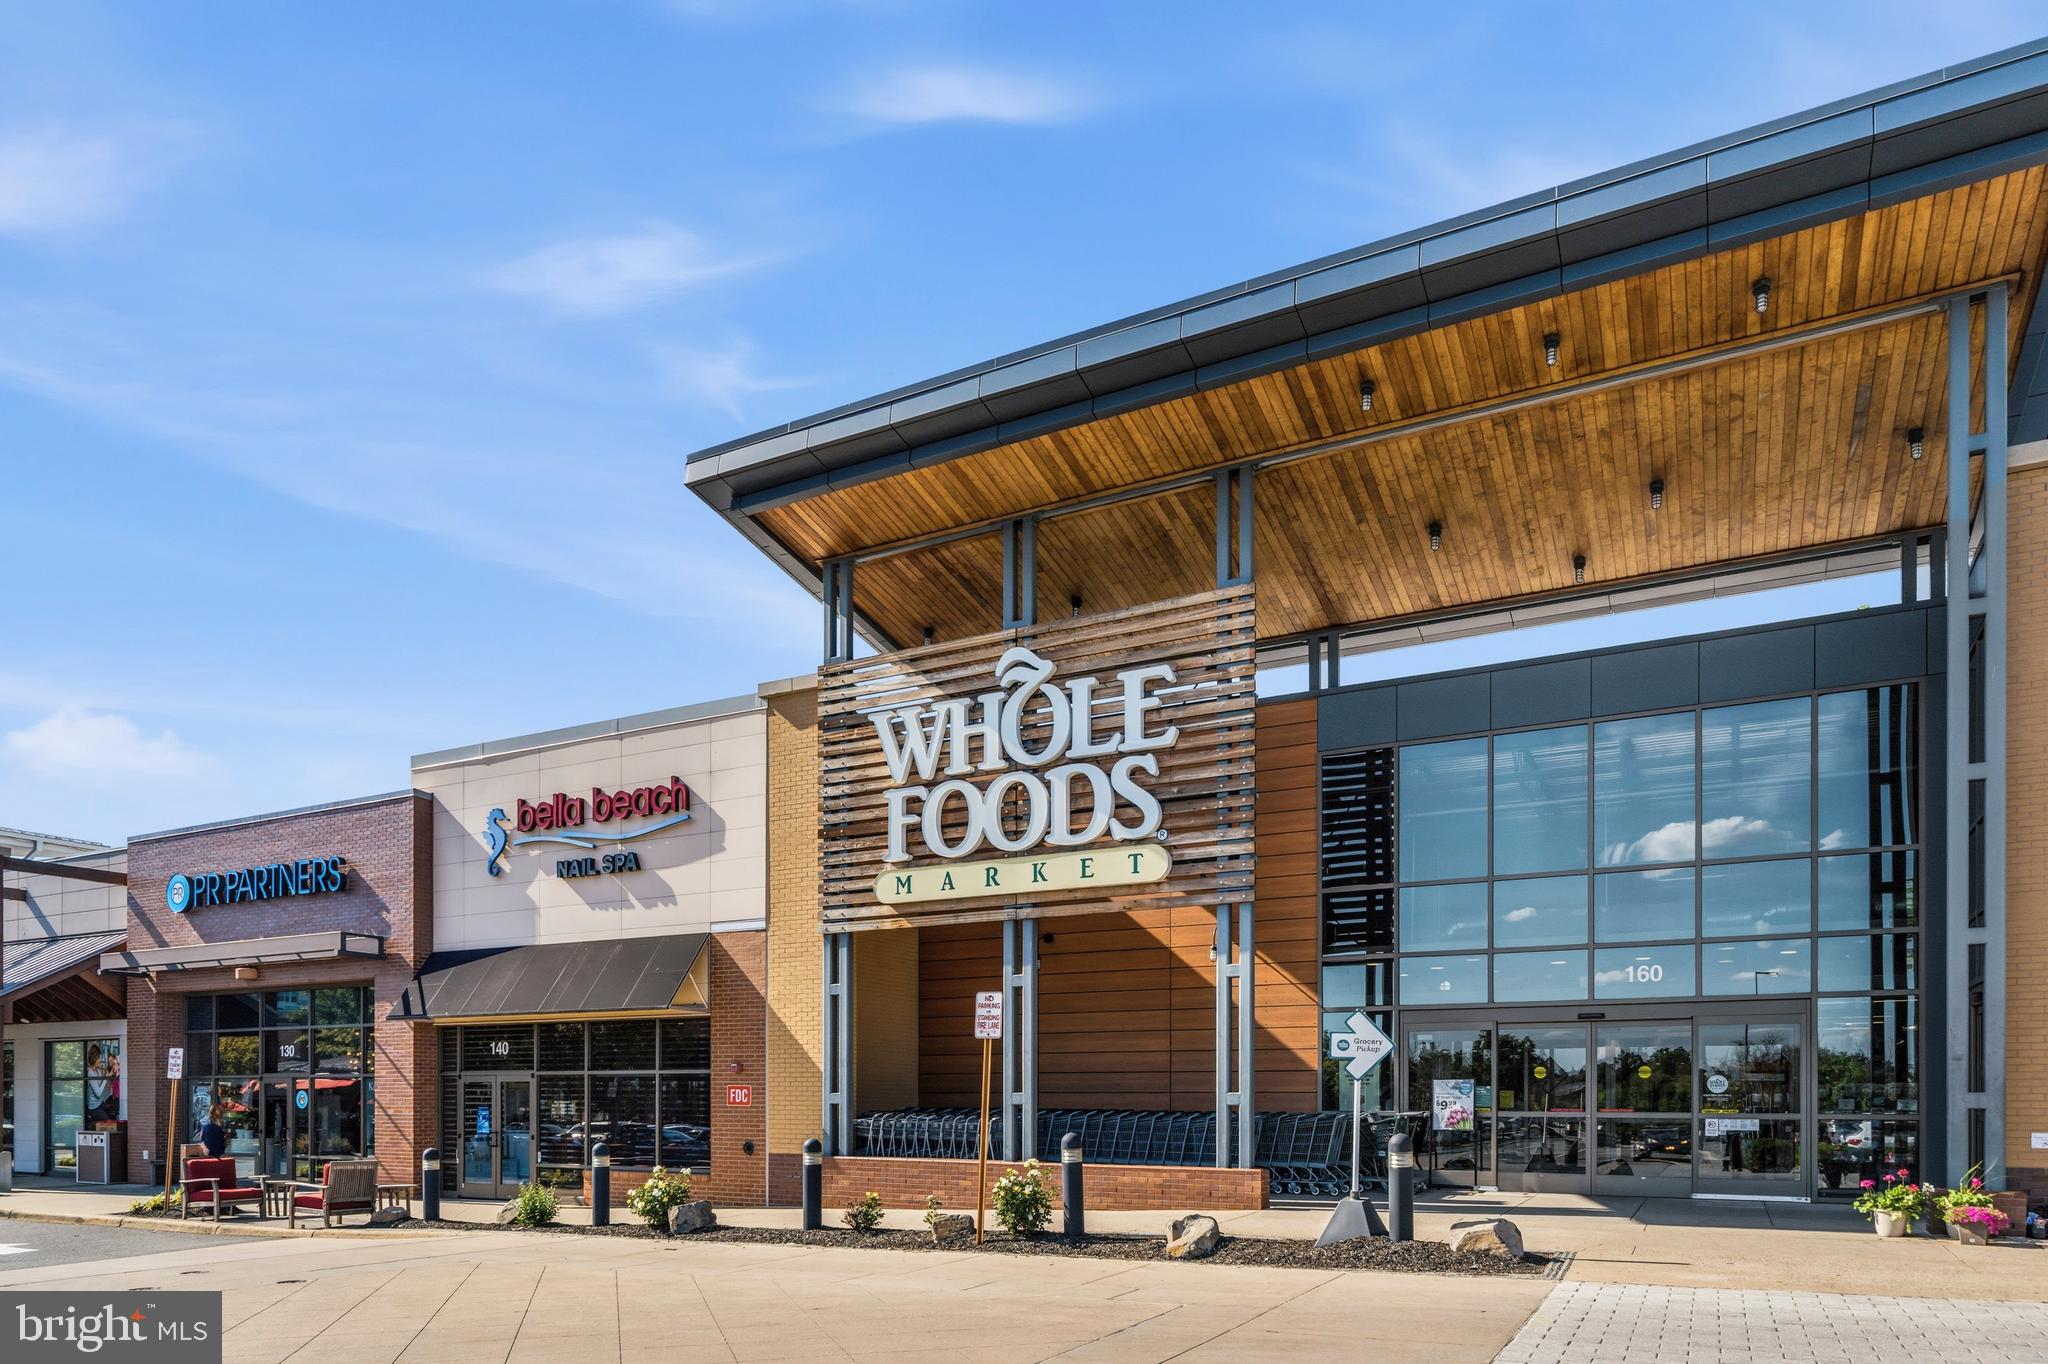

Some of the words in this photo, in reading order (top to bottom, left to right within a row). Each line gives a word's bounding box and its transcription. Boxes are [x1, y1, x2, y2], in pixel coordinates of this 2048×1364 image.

[867, 647, 1180, 785] WHOLE
[517, 798, 585, 832] bella
[592, 776, 691, 823] beach
[881, 753, 1163, 863] FOODS
[556, 857, 599, 879] NAIL
[602, 852, 641, 874] SPA
[895, 853, 1144, 895] MARKET
[193, 872, 220, 908] PR
[225, 854, 343, 904] PARTNERS
[1625, 964, 1663, 983] 160
[279, 1044, 295, 1058] 130
[489, 1041, 509, 1055] 140
[1353, 1037, 1383, 1047] Grocery
[1356, 1045, 1381, 1054] Pickup
[730, 1088, 749, 1103] FDC
